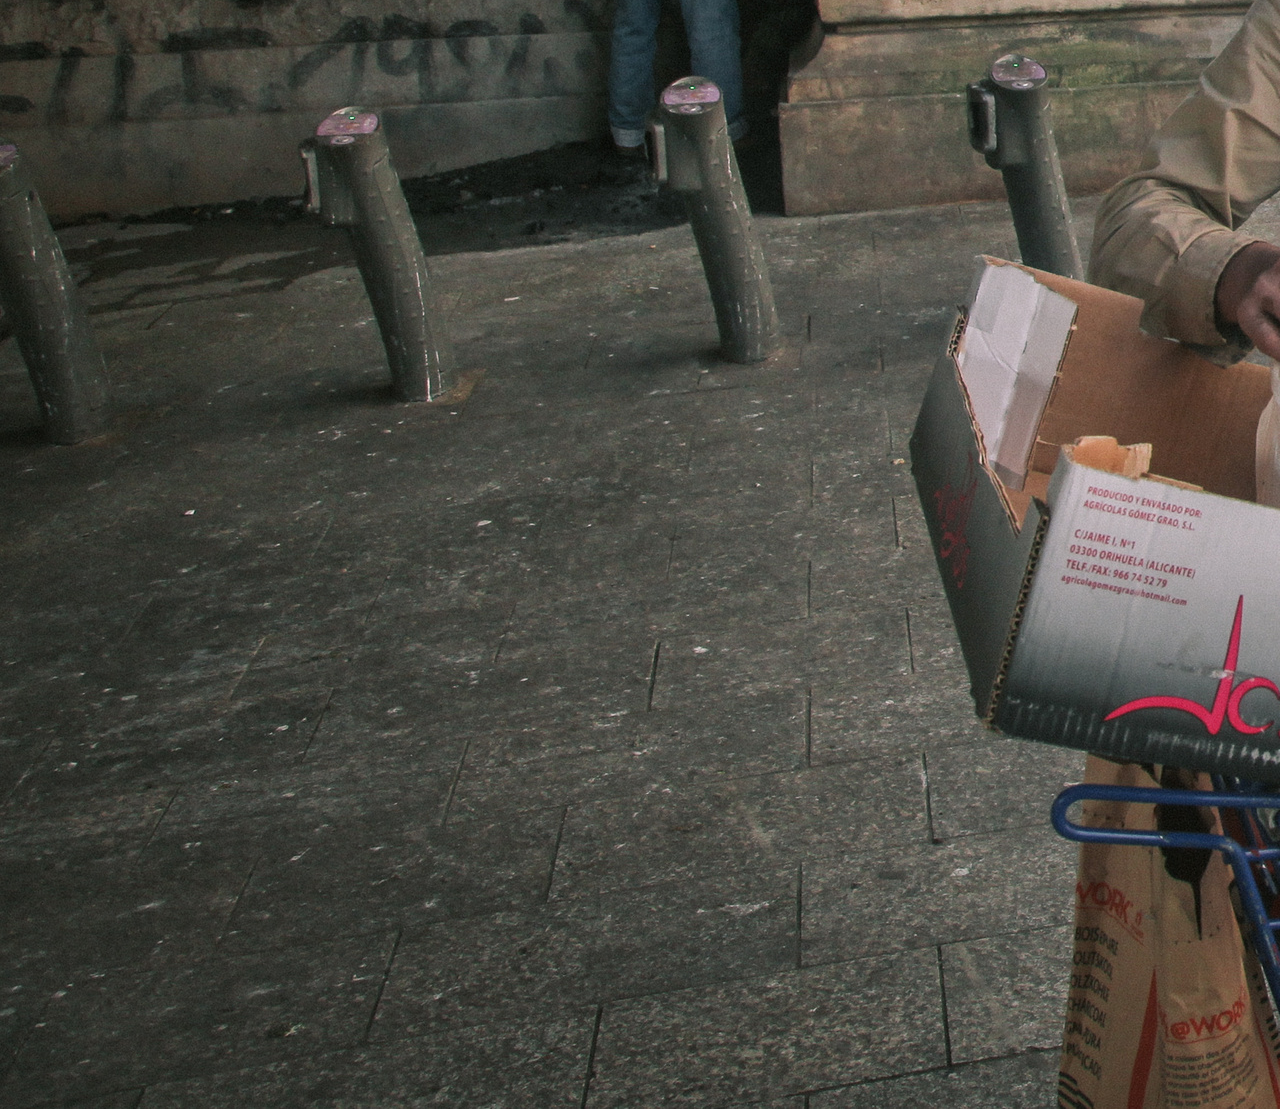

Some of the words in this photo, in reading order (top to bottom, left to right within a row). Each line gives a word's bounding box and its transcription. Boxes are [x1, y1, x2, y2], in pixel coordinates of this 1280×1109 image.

[1087, 486, 1134, 504] PRODUCIDO
[1135, 496, 1141, 505] Y
[1141, 497, 1184, 515] ENVASADO
[1184, 508, 1203, 518] POR:
[1128, 508, 1156, 522] GÓMEZ
[1157, 515, 1180, 529] GRAO,
[1181, 522, 1196, 531] S.L.
[1074, 528, 1110, 545] C/JAIME
[1066, 559, 1112, 577] TELF./FAX:
[1113, 569, 1129, 580] 966
[1131, 572, 1142, 582] 74
[1143, 575, 1155, 586] 52
[1156, 578, 1168, 589] 79
[1069, 544, 1098, 558] 03300
[1099, 550, 1144, 568] ORIHUELA
[1145, 560, 1197, 579] (ALICANTE)
